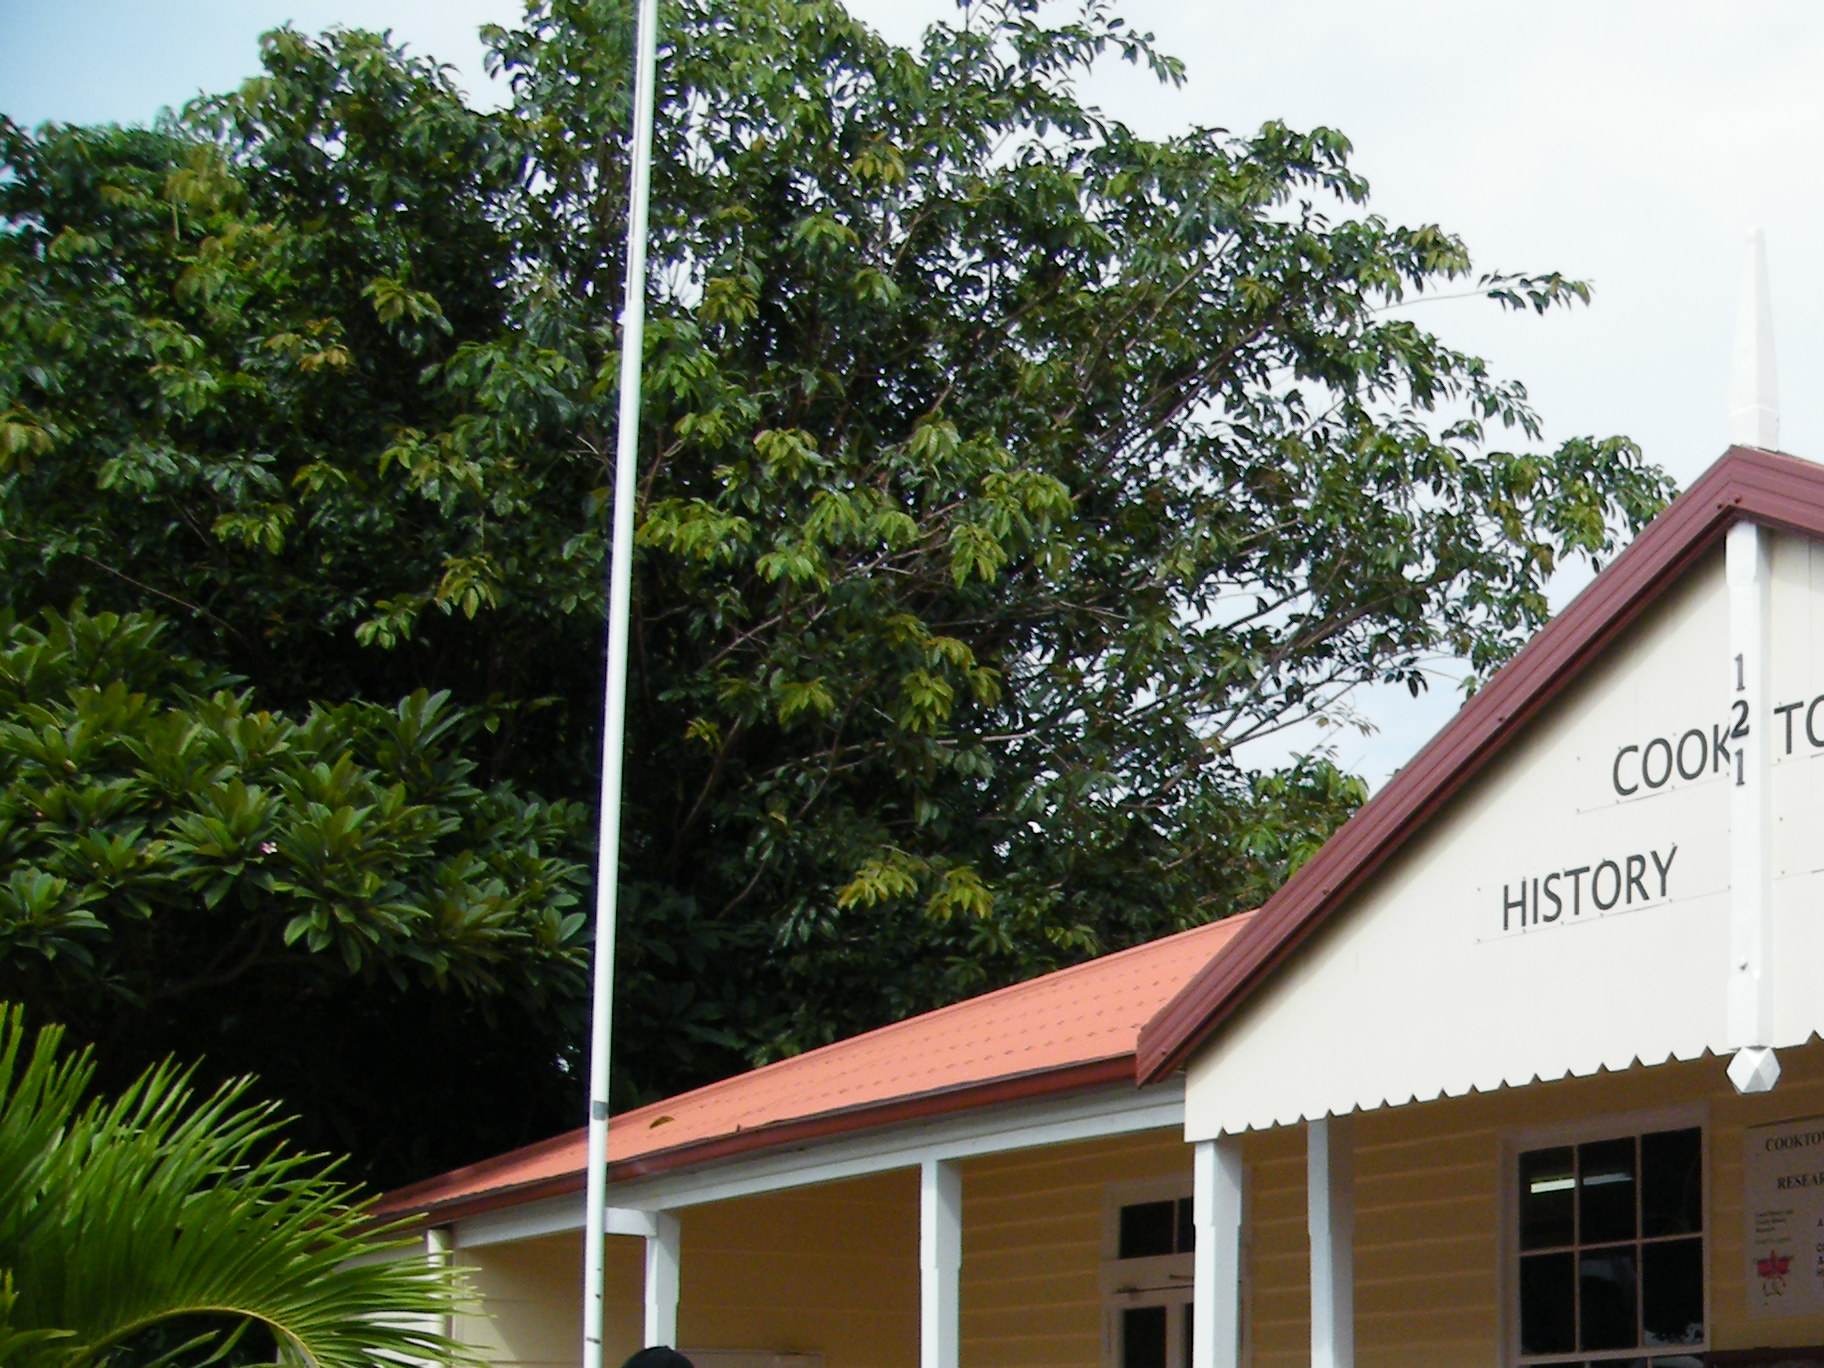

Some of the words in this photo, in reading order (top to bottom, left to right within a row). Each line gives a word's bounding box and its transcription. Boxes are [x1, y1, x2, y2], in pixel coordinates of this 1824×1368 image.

[1731, 653, 1750, 786] 121
[1503, 846, 1677, 930] HISTORY
[1817, 1218, 1824, 1227] A
